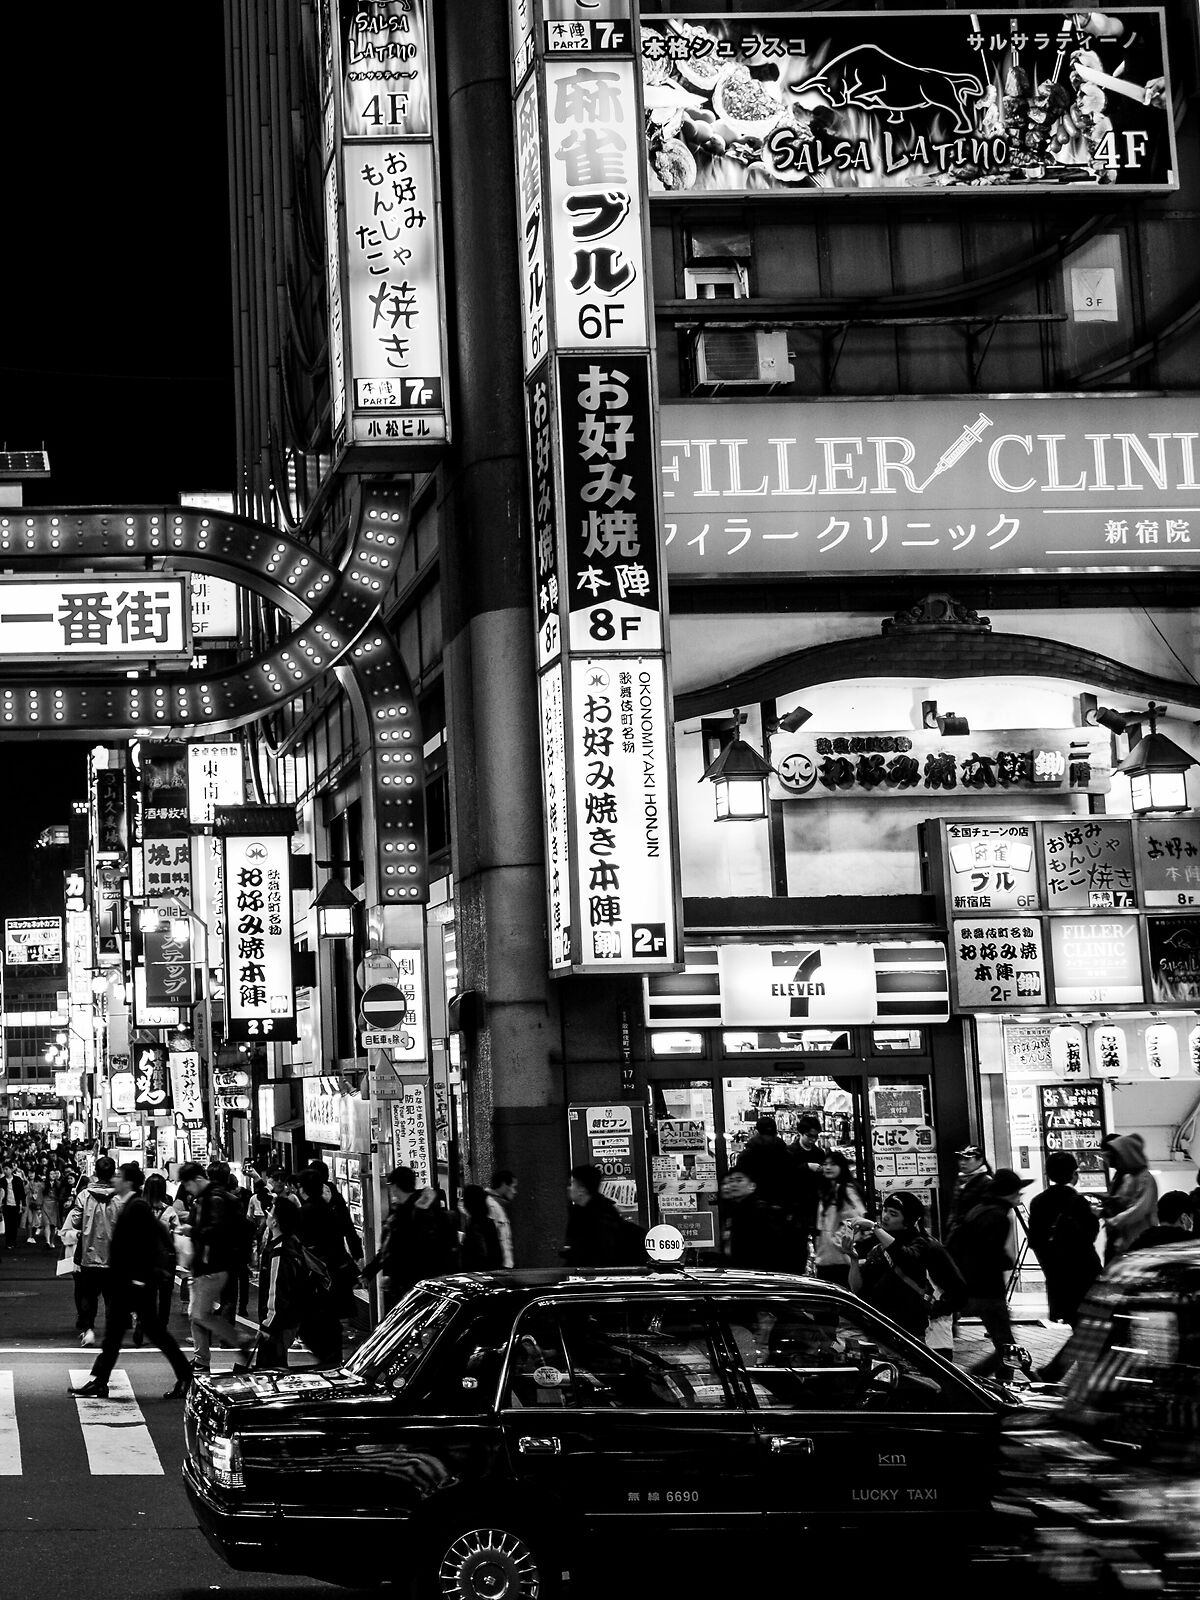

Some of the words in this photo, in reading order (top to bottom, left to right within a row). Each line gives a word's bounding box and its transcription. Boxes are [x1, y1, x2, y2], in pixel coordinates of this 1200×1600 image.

[354, 11, 409, 34] SALSA
[553, 23, 586, 38] 本陣
[554, 38, 589, 49] PART2
[596, 22, 624, 48] 7F
[967, 31, 1138, 51] サルサラティーノ
[348, 38, 418, 63] LATINO
[644, 36, 808, 59] 本格シュラスコ
[349, 71, 418, 81] サルサラティーノ
[361, 94, 409, 126] 4F
[770, 130, 872, 175] SALSA
[883, 131, 1007, 173] LATINO
[1093, 130, 1148, 170] 4F
[1086, 297, 1103, 308] 3F
[579, 304, 625, 340] 6F
[363, 395, 396, 406] PART2
[405, 380, 434, 405] 7F
[368, 420, 430, 437] 小松ビル
[577, 365, 641, 557] お好み焼
[817, 513, 1020, 553] クリニック
[1104, 519, 1191, 545] 新宿院
[577, 561, 650, 598] 本陣
[589, 608, 642, 641] 8F
[619, 672, 635, 753] 歌舞伎町名物
[638, 672, 656, 788] OKONOMIYAKI
[583, 694, 623, 927] お好み焼き本陣
[643, 793, 660, 858] HONJIN
[951, 826, 1030, 838] 全国チェーンの店
[1047, 822, 1102, 854] お好み
[971, 871, 1015, 892] ブル
[954, 895, 991, 908] 新宿店
[1017, 895, 1036, 907] 6F
[1115, 892, 1132, 908] 7F
[1177, 893, 1195, 905] 8F
[237, 866, 267, 1008] お好み焼本陣
[634, 928, 666, 953] 2F
[960, 927, 1035, 940] 歌舞伎町名物
[1061, 924, 1126, 940] FILLER
[959, 943, 1038, 961] お好み焼
[1063, 942, 1126, 958] CLINIC
[974, 963, 1015, 981] 本陣
[990, 986, 1012, 1001] 2F
[248, 1018, 274, 1035] 2F
[365, 1034, 406, 1045] 自転車を除く
[623, 1069, 634, 1079] 17
[660, 1120, 705, 1132] ATM
[872, 1129, 910, 1147] たばこ
[915, 1129, 932, 1146] 酒
[659, 1239, 680, 1250] 6690
[666, 1490, 700, 1503] 6690
[851, 1489, 899, 1502] LUCKY
[907, 1488, 938, 1501] TAXI
